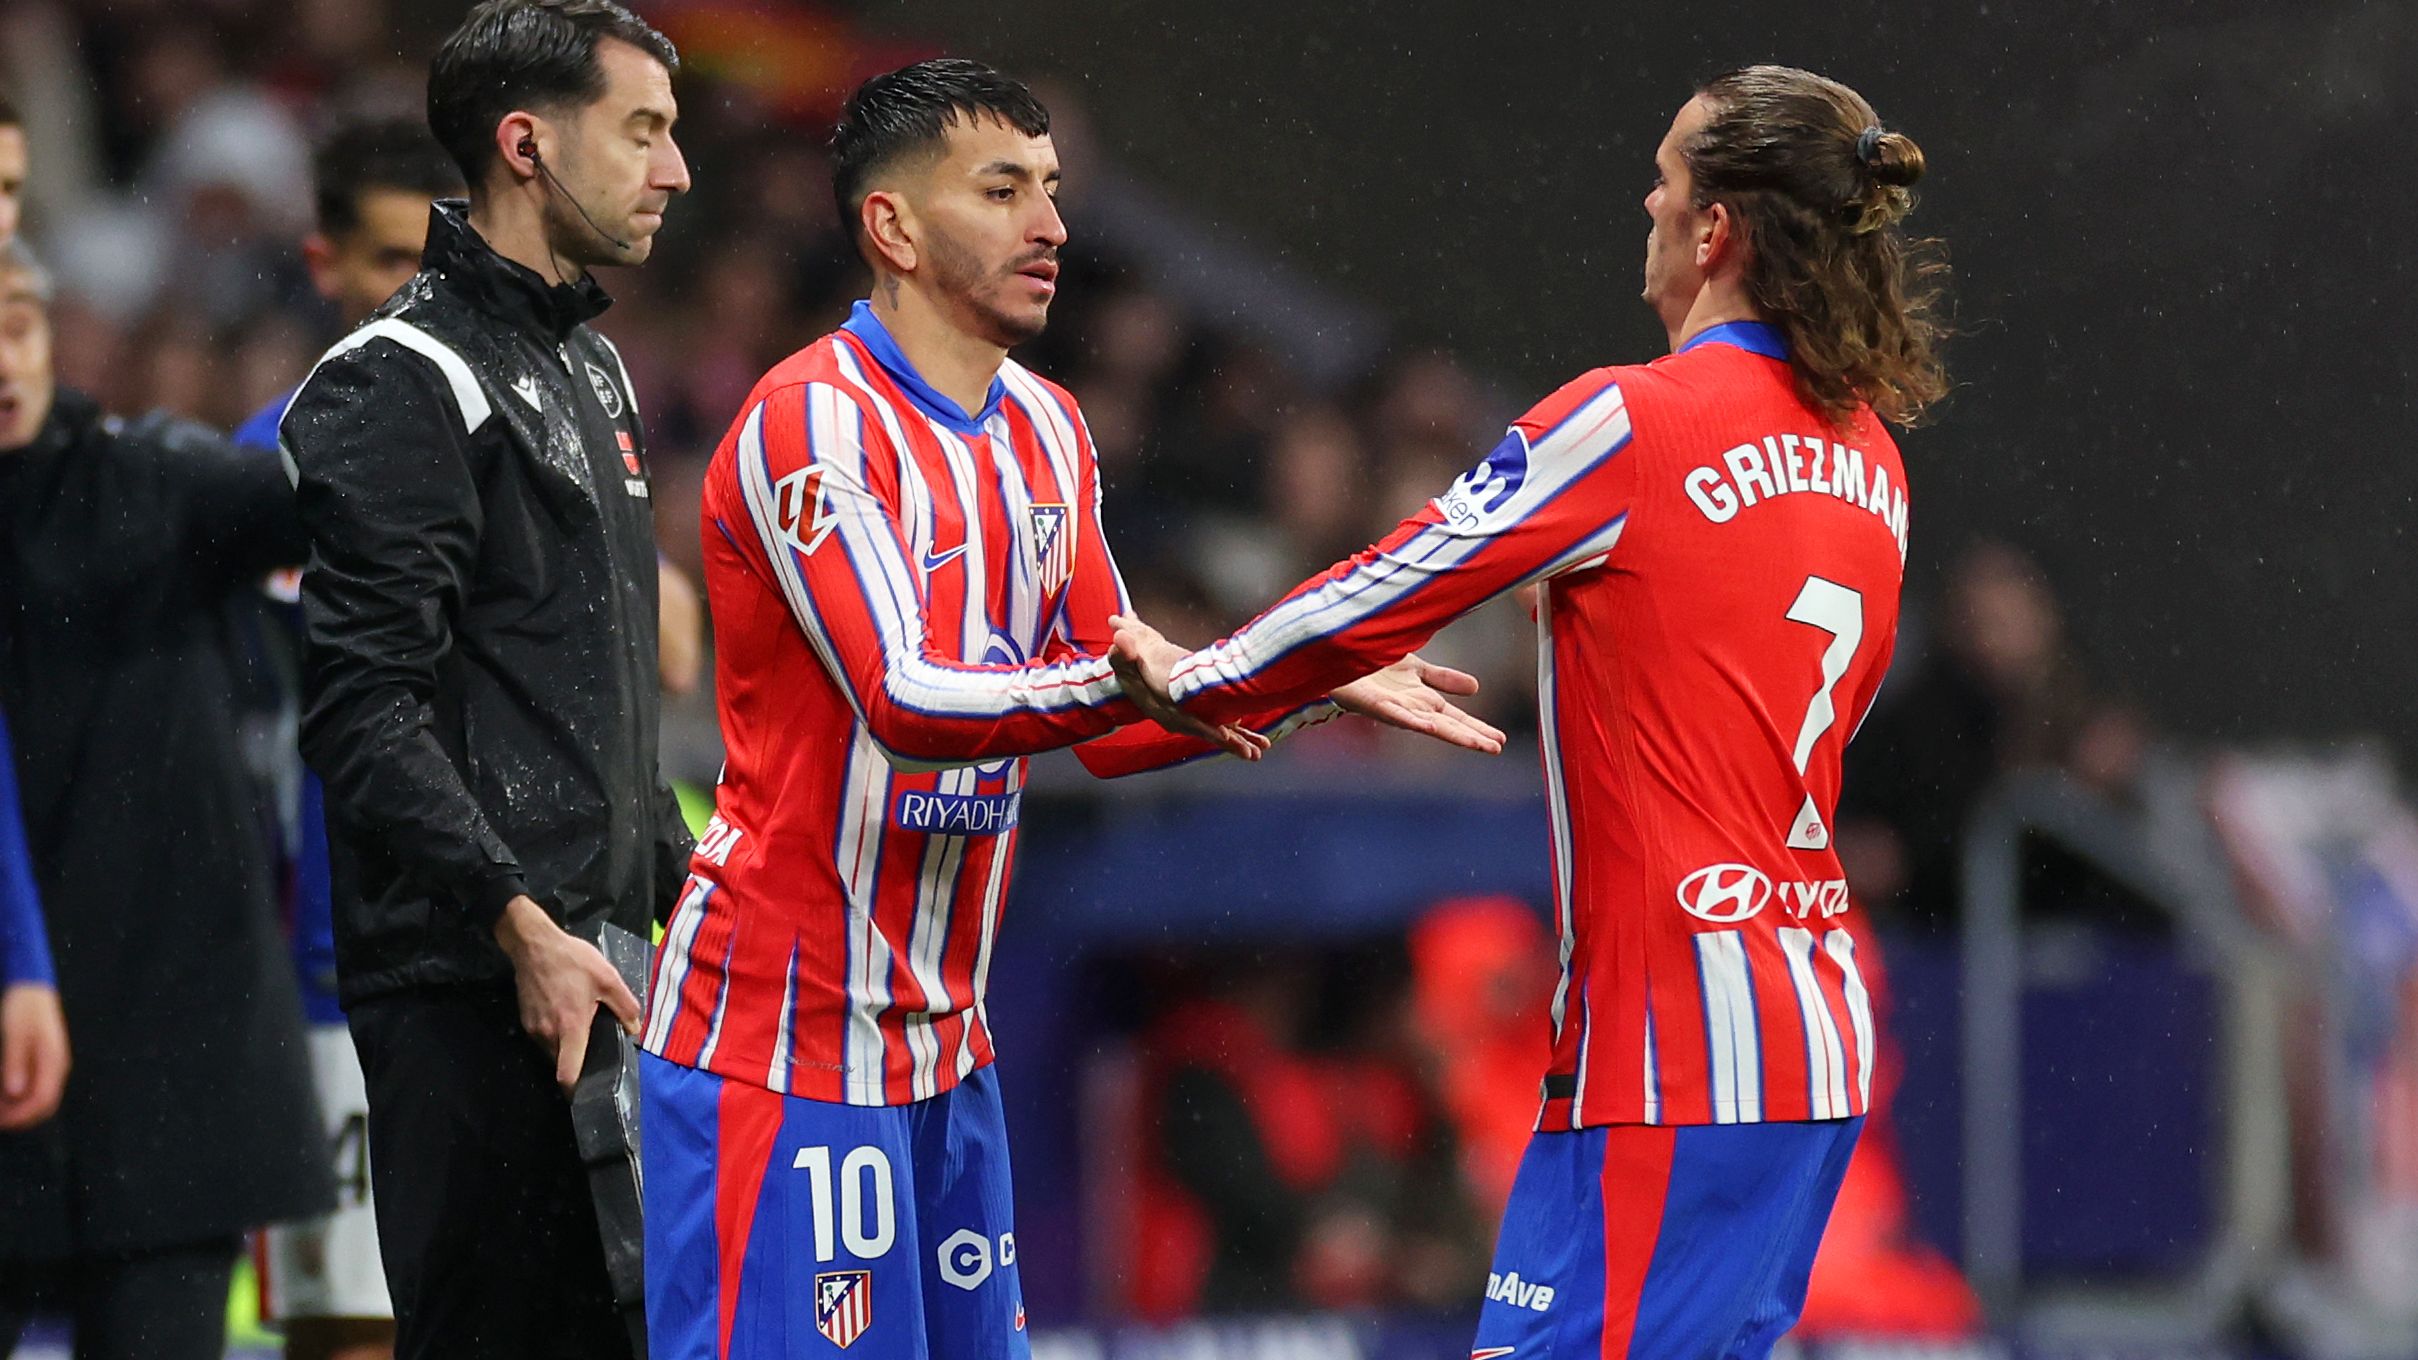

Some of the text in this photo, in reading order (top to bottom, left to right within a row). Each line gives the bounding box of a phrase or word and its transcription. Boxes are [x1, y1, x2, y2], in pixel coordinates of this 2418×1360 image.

[1442, 491, 1480, 532] ken
[1684, 433, 1910, 583] GRIEZMAN
[1785, 574, 1863, 850] 7
[902, 794, 1005, 831] RIYADH
[793, 1145, 896, 1262] 10
